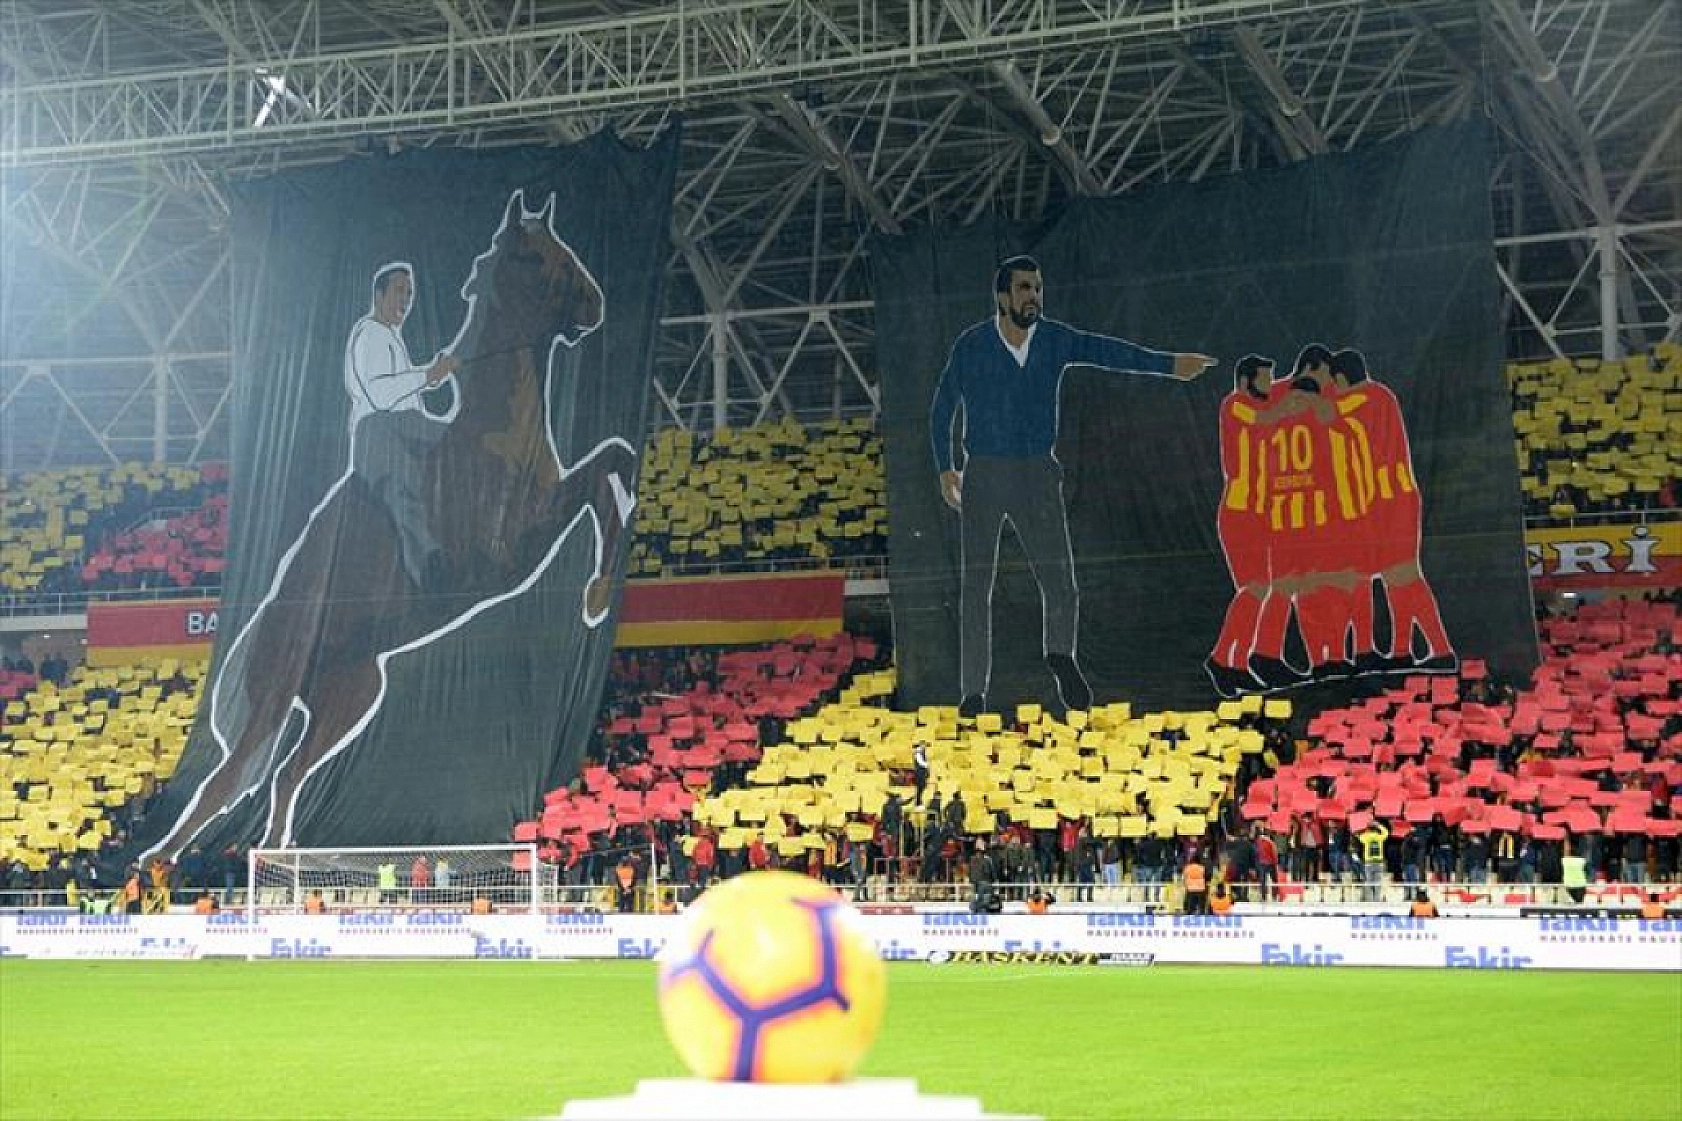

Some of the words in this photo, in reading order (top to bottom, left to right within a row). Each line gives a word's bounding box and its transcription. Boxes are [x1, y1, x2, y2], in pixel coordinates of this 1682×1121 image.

[1271, 424, 1313, 471] 10
[1261, 943, 1344, 966] Fakir
[1445, 946, 1532, 968] Fakir
